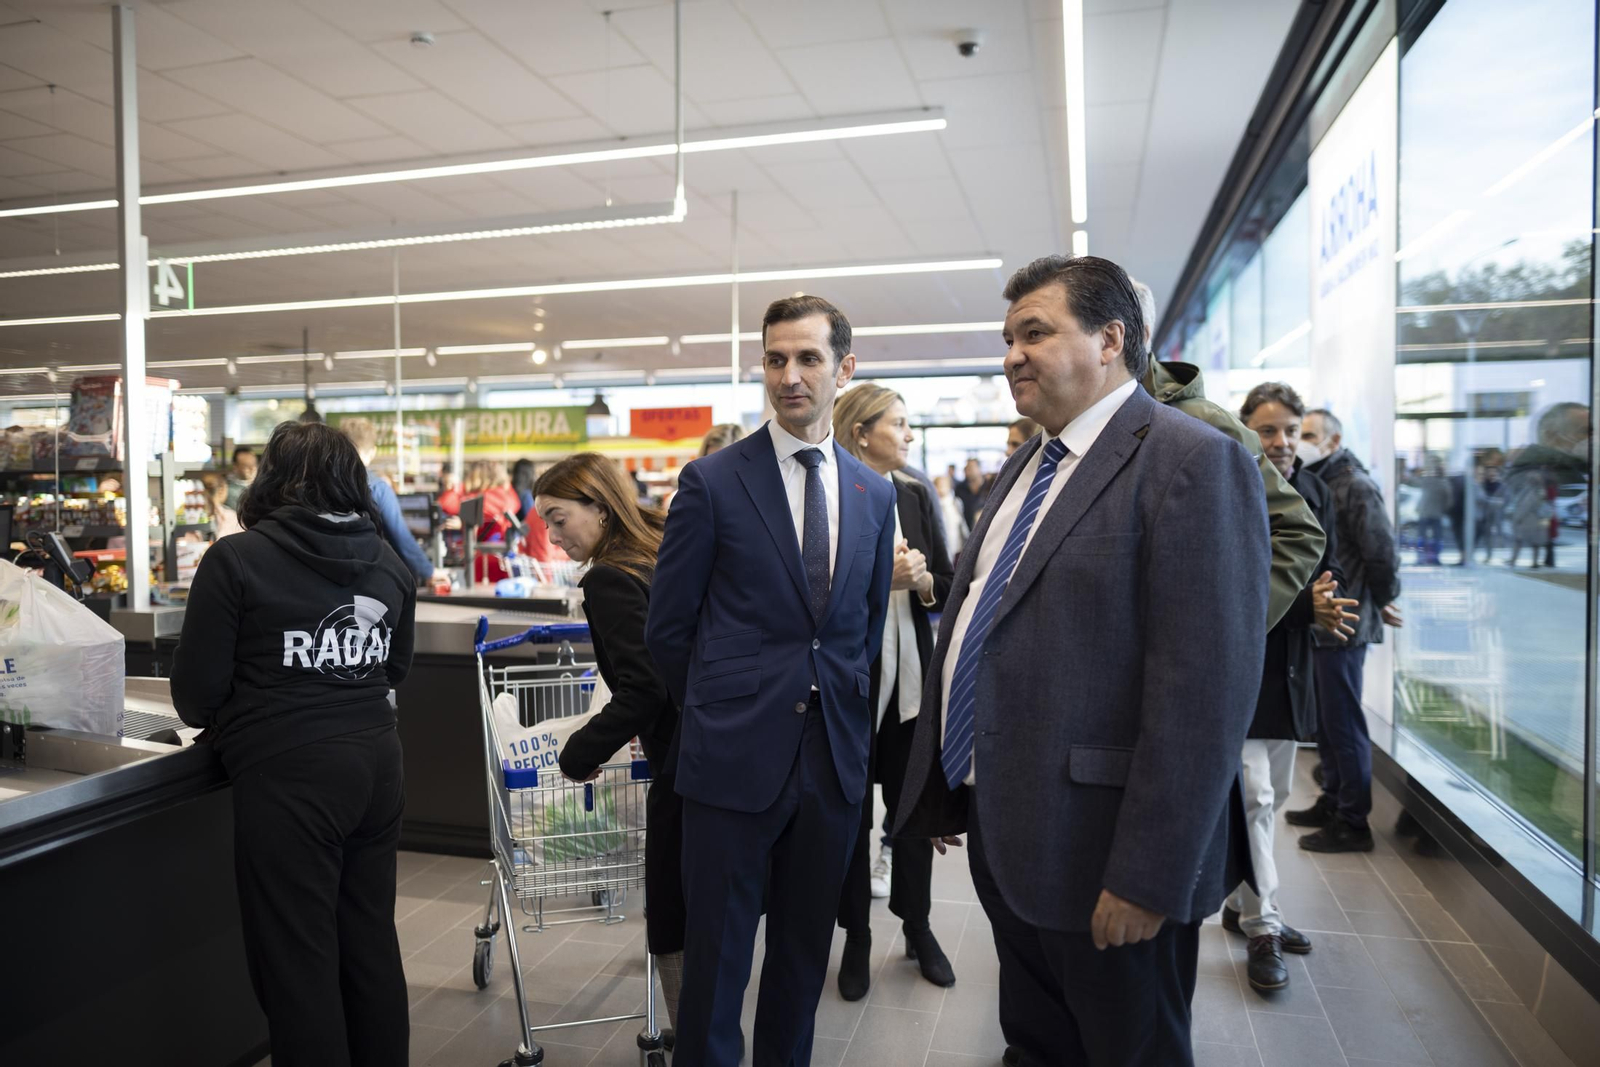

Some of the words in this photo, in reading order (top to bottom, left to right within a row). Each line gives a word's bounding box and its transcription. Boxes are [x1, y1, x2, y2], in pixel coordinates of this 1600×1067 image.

[444, 410, 571, 438] VERDURA
[509, 732, 558, 756] 100%
[514, 750, 559, 769] RECICL
